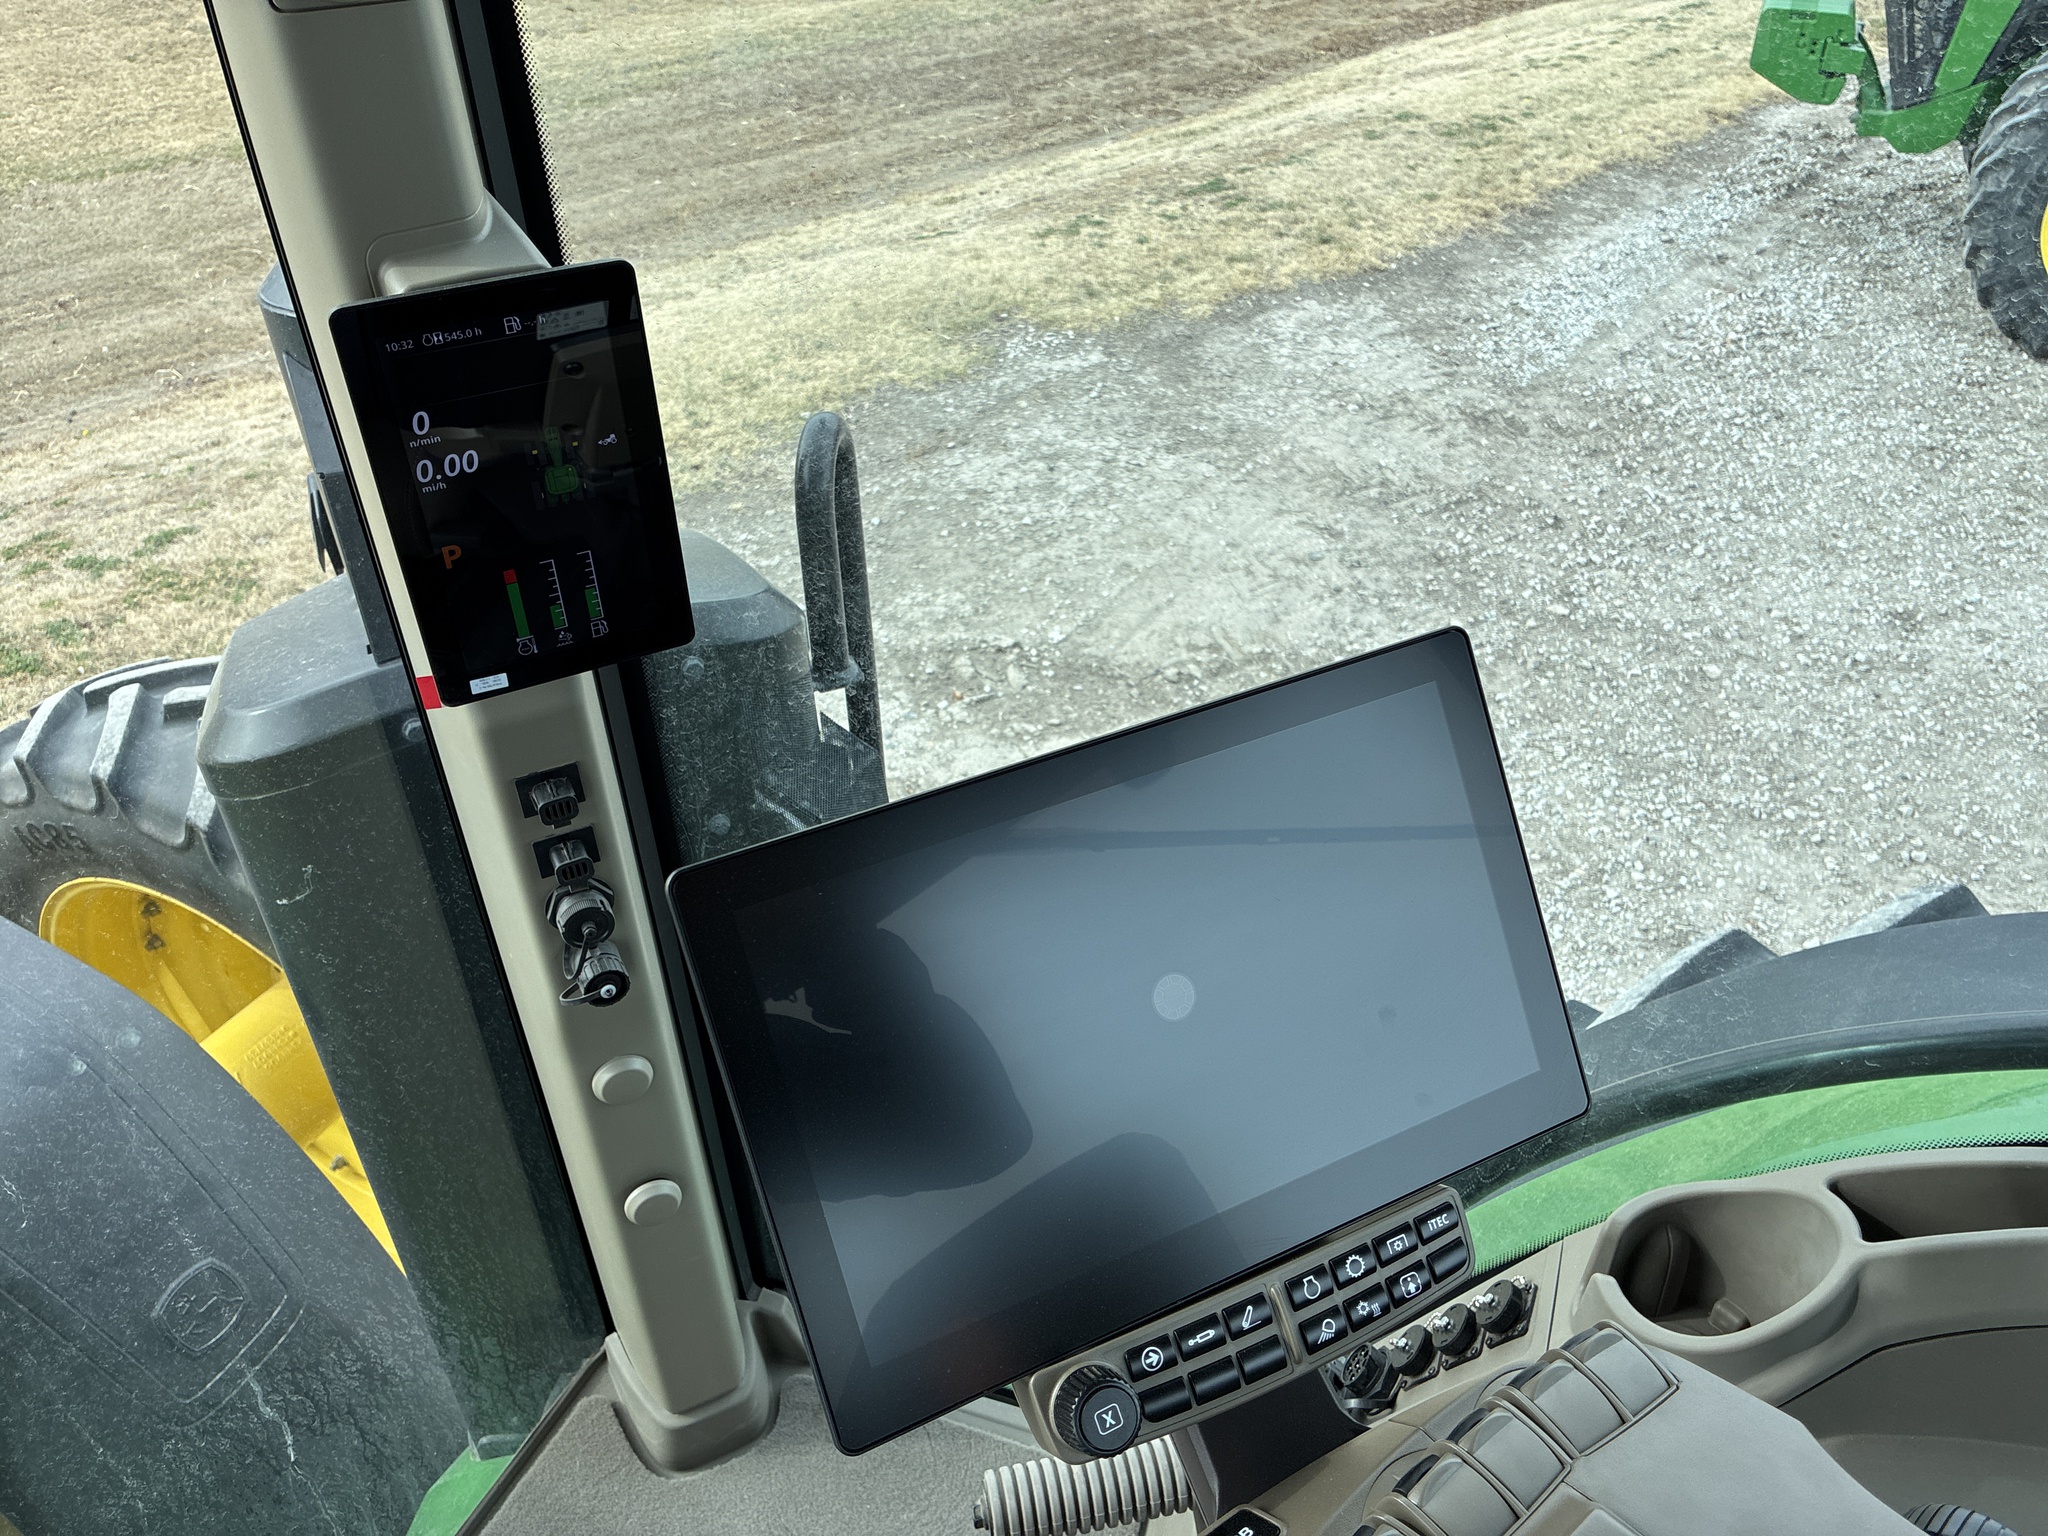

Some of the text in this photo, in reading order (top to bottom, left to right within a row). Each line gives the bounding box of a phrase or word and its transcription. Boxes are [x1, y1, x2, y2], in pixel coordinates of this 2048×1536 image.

[385, 339, 415, 353] 10:32
[444, 328, 473, 343] 545.0
[474, 326, 483, 337] h
[538, 315, 546, 324] h
[412, 411, 430, 436] 0
[409, 435, 442, 449] n/min
[416, 449, 479, 483] 0.00
[422, 481, 447, 494] mi/h
[441, 544, 462, 570] P
[1427, 1213, 1450, 1231] iTEC
[1101, 1409, 1117, 1429] X
